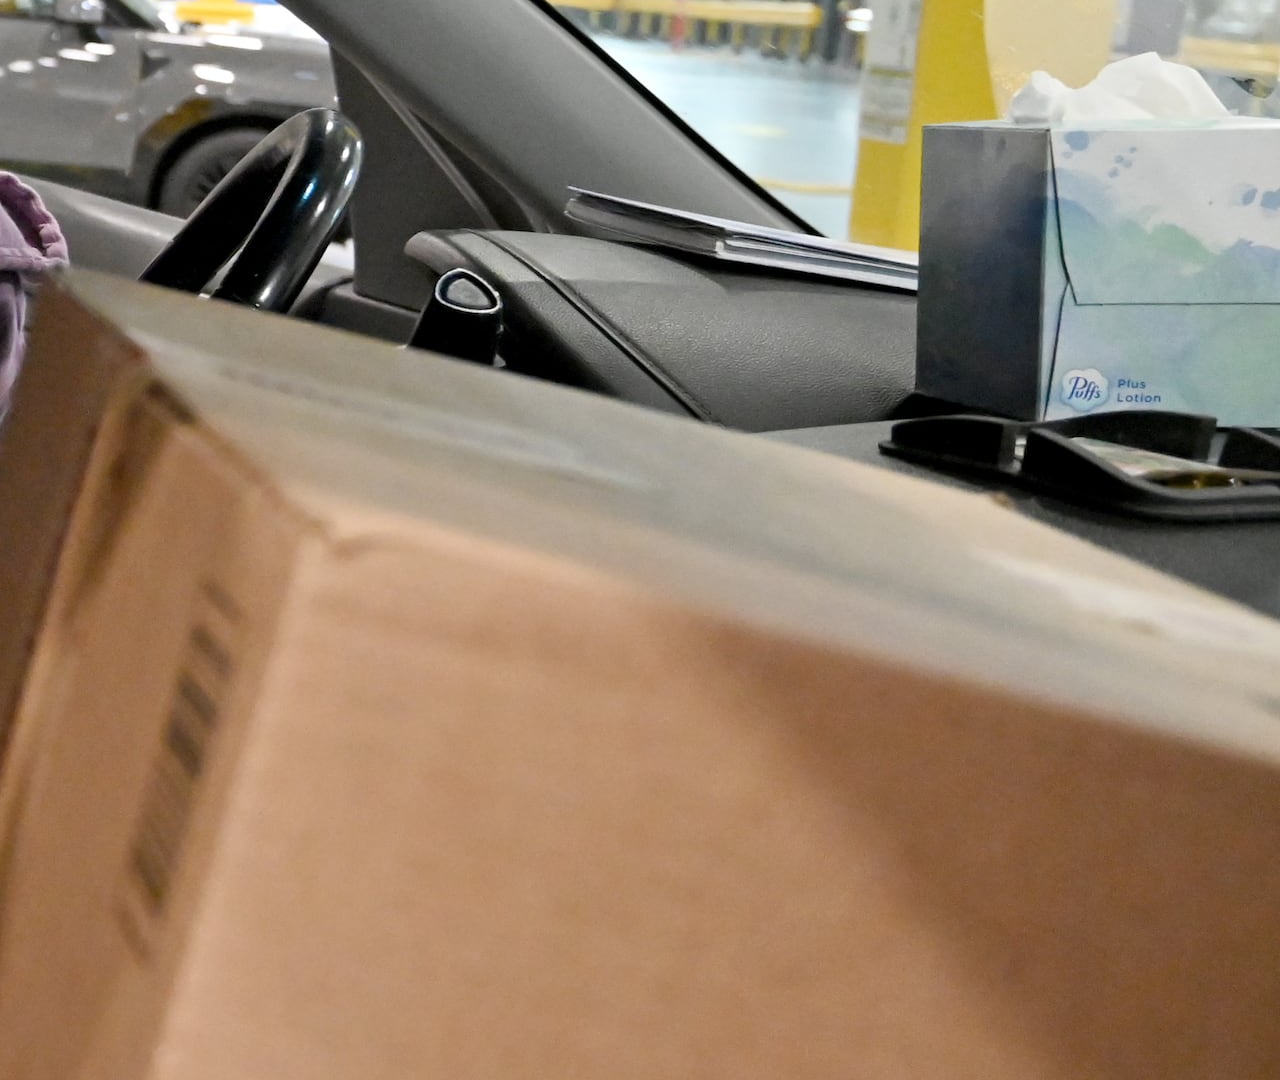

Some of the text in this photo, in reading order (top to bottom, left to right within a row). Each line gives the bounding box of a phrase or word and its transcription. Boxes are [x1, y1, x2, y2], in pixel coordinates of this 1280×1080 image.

[1068, 376, 1102, 401] Puffs
[1118, 378, 1147, 390] Plus
[1117, 393, 1162, 403] Lotion
